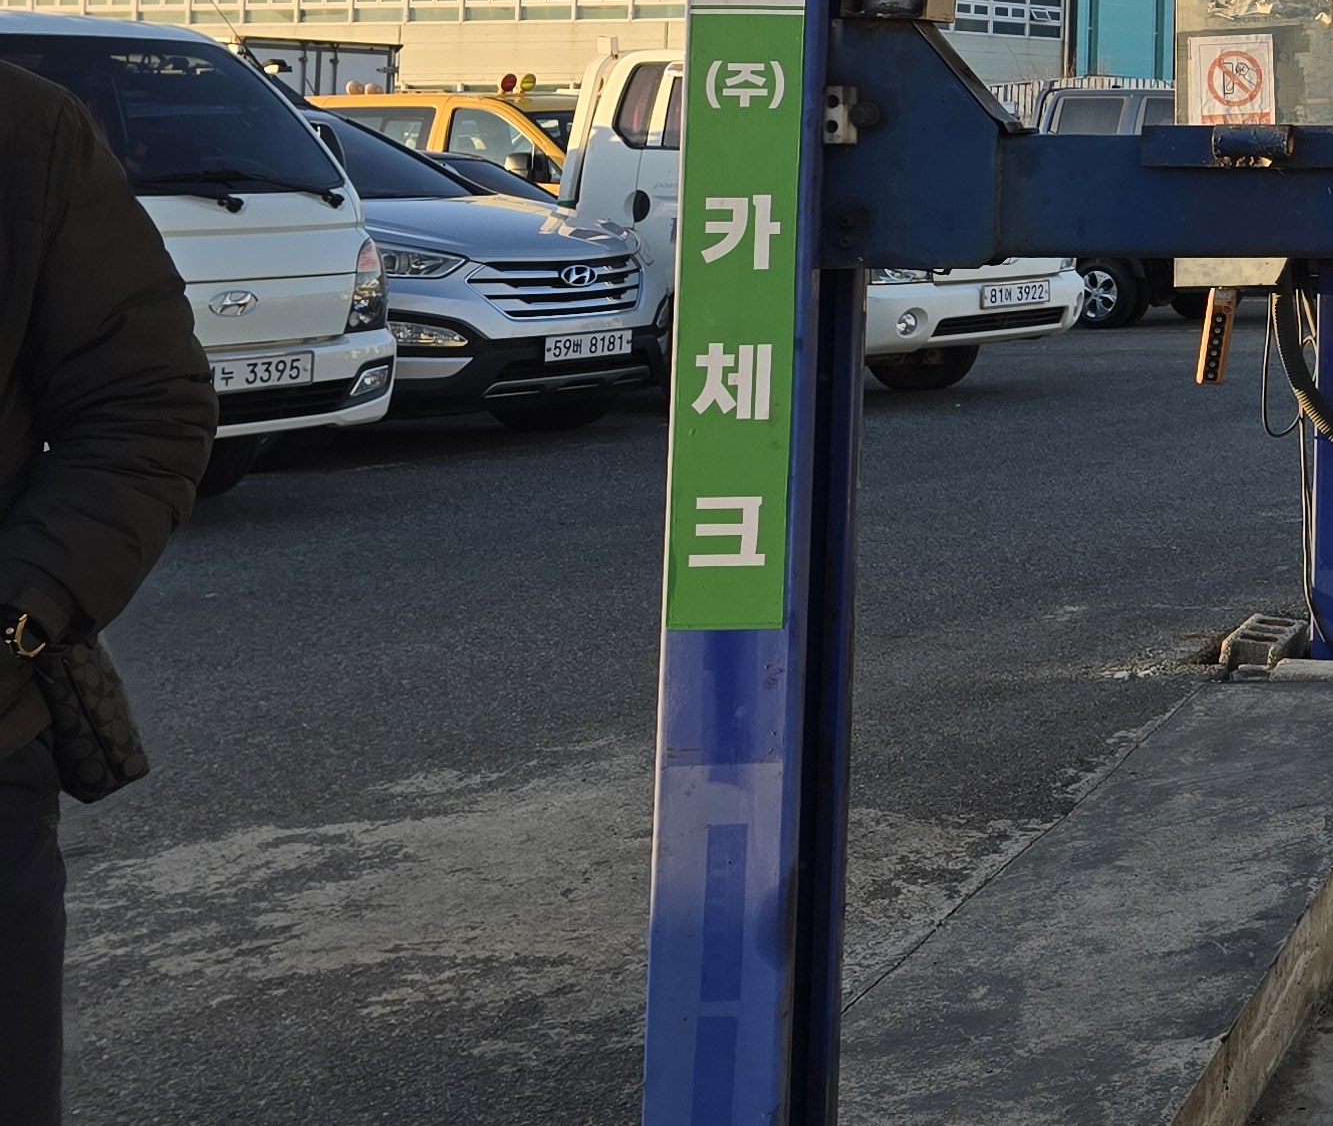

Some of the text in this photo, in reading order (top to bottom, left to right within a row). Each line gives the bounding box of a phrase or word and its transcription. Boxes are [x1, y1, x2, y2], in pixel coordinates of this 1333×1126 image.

[1017, 284, 1044, 302] 3922
[553, 334, 623, 358] 59버 8181
[245, 358, 301, 385] 3395
